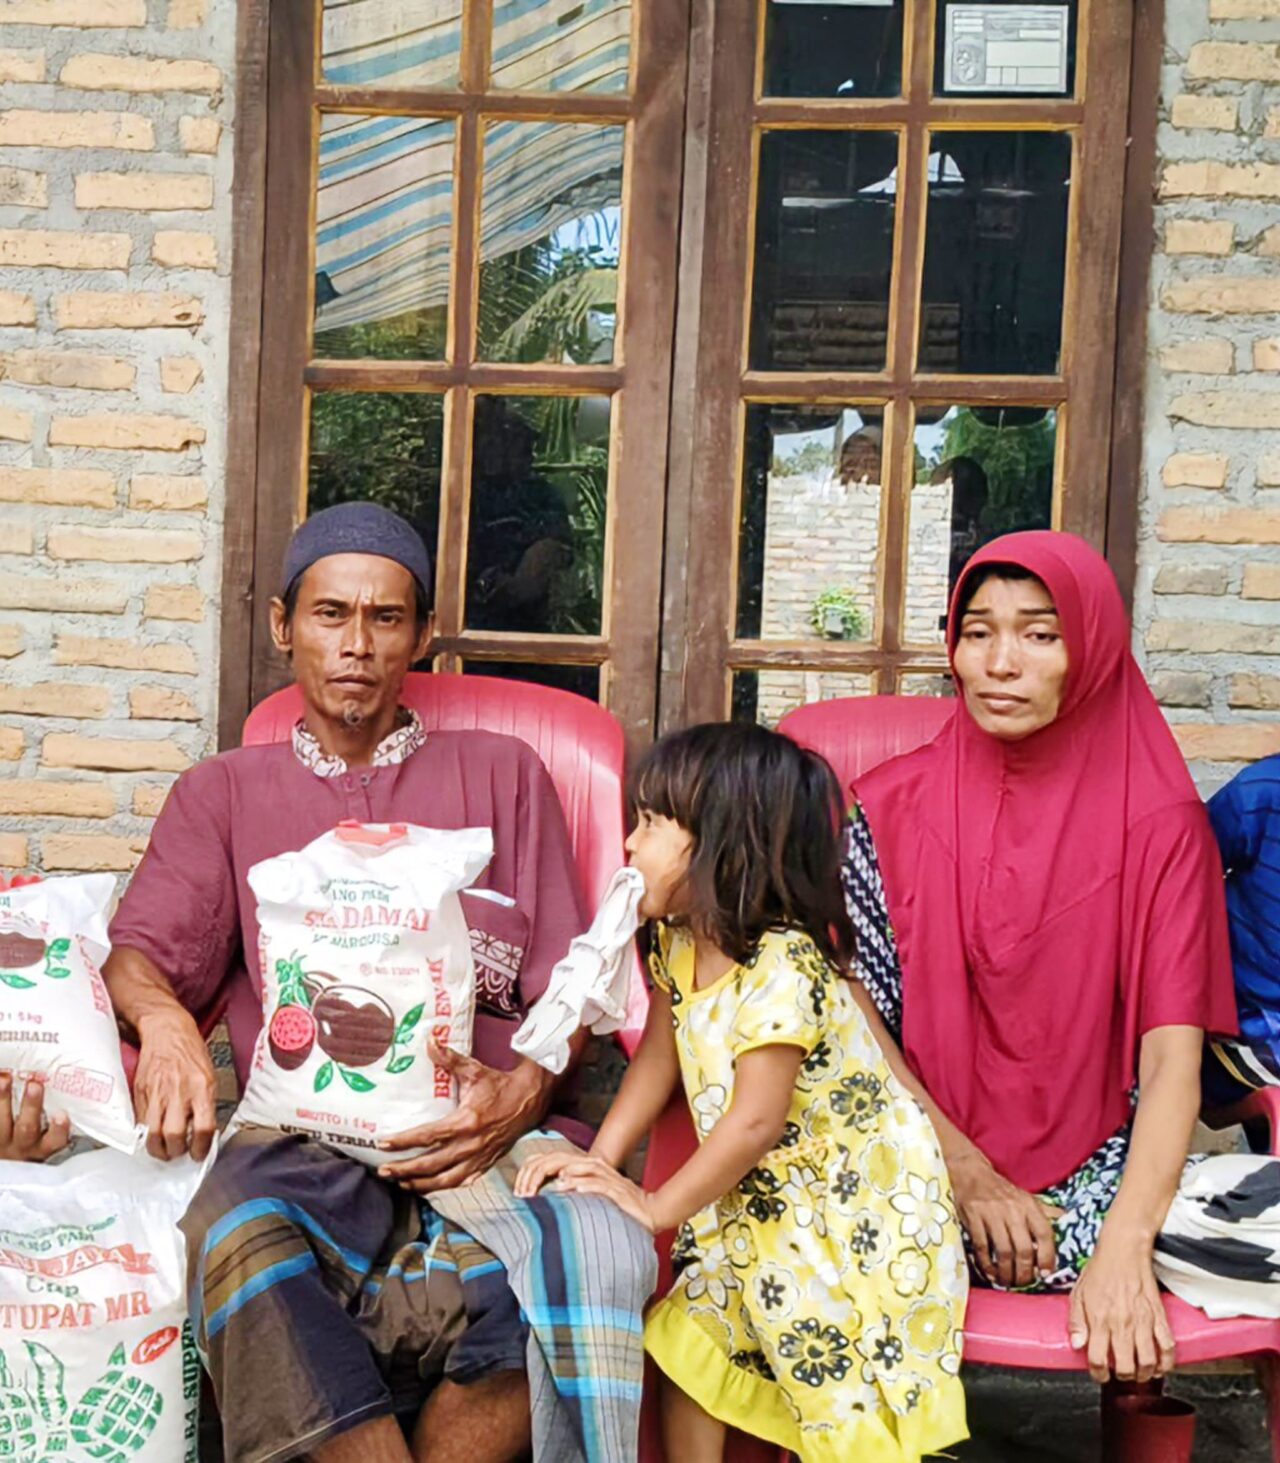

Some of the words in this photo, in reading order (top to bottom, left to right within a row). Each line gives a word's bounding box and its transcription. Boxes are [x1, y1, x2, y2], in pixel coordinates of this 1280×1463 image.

[326, 1131, 377, 1149] TERBA
[51, 1246, 128, 1277] JAYA
[105, 1290, 152, 1323] MR
